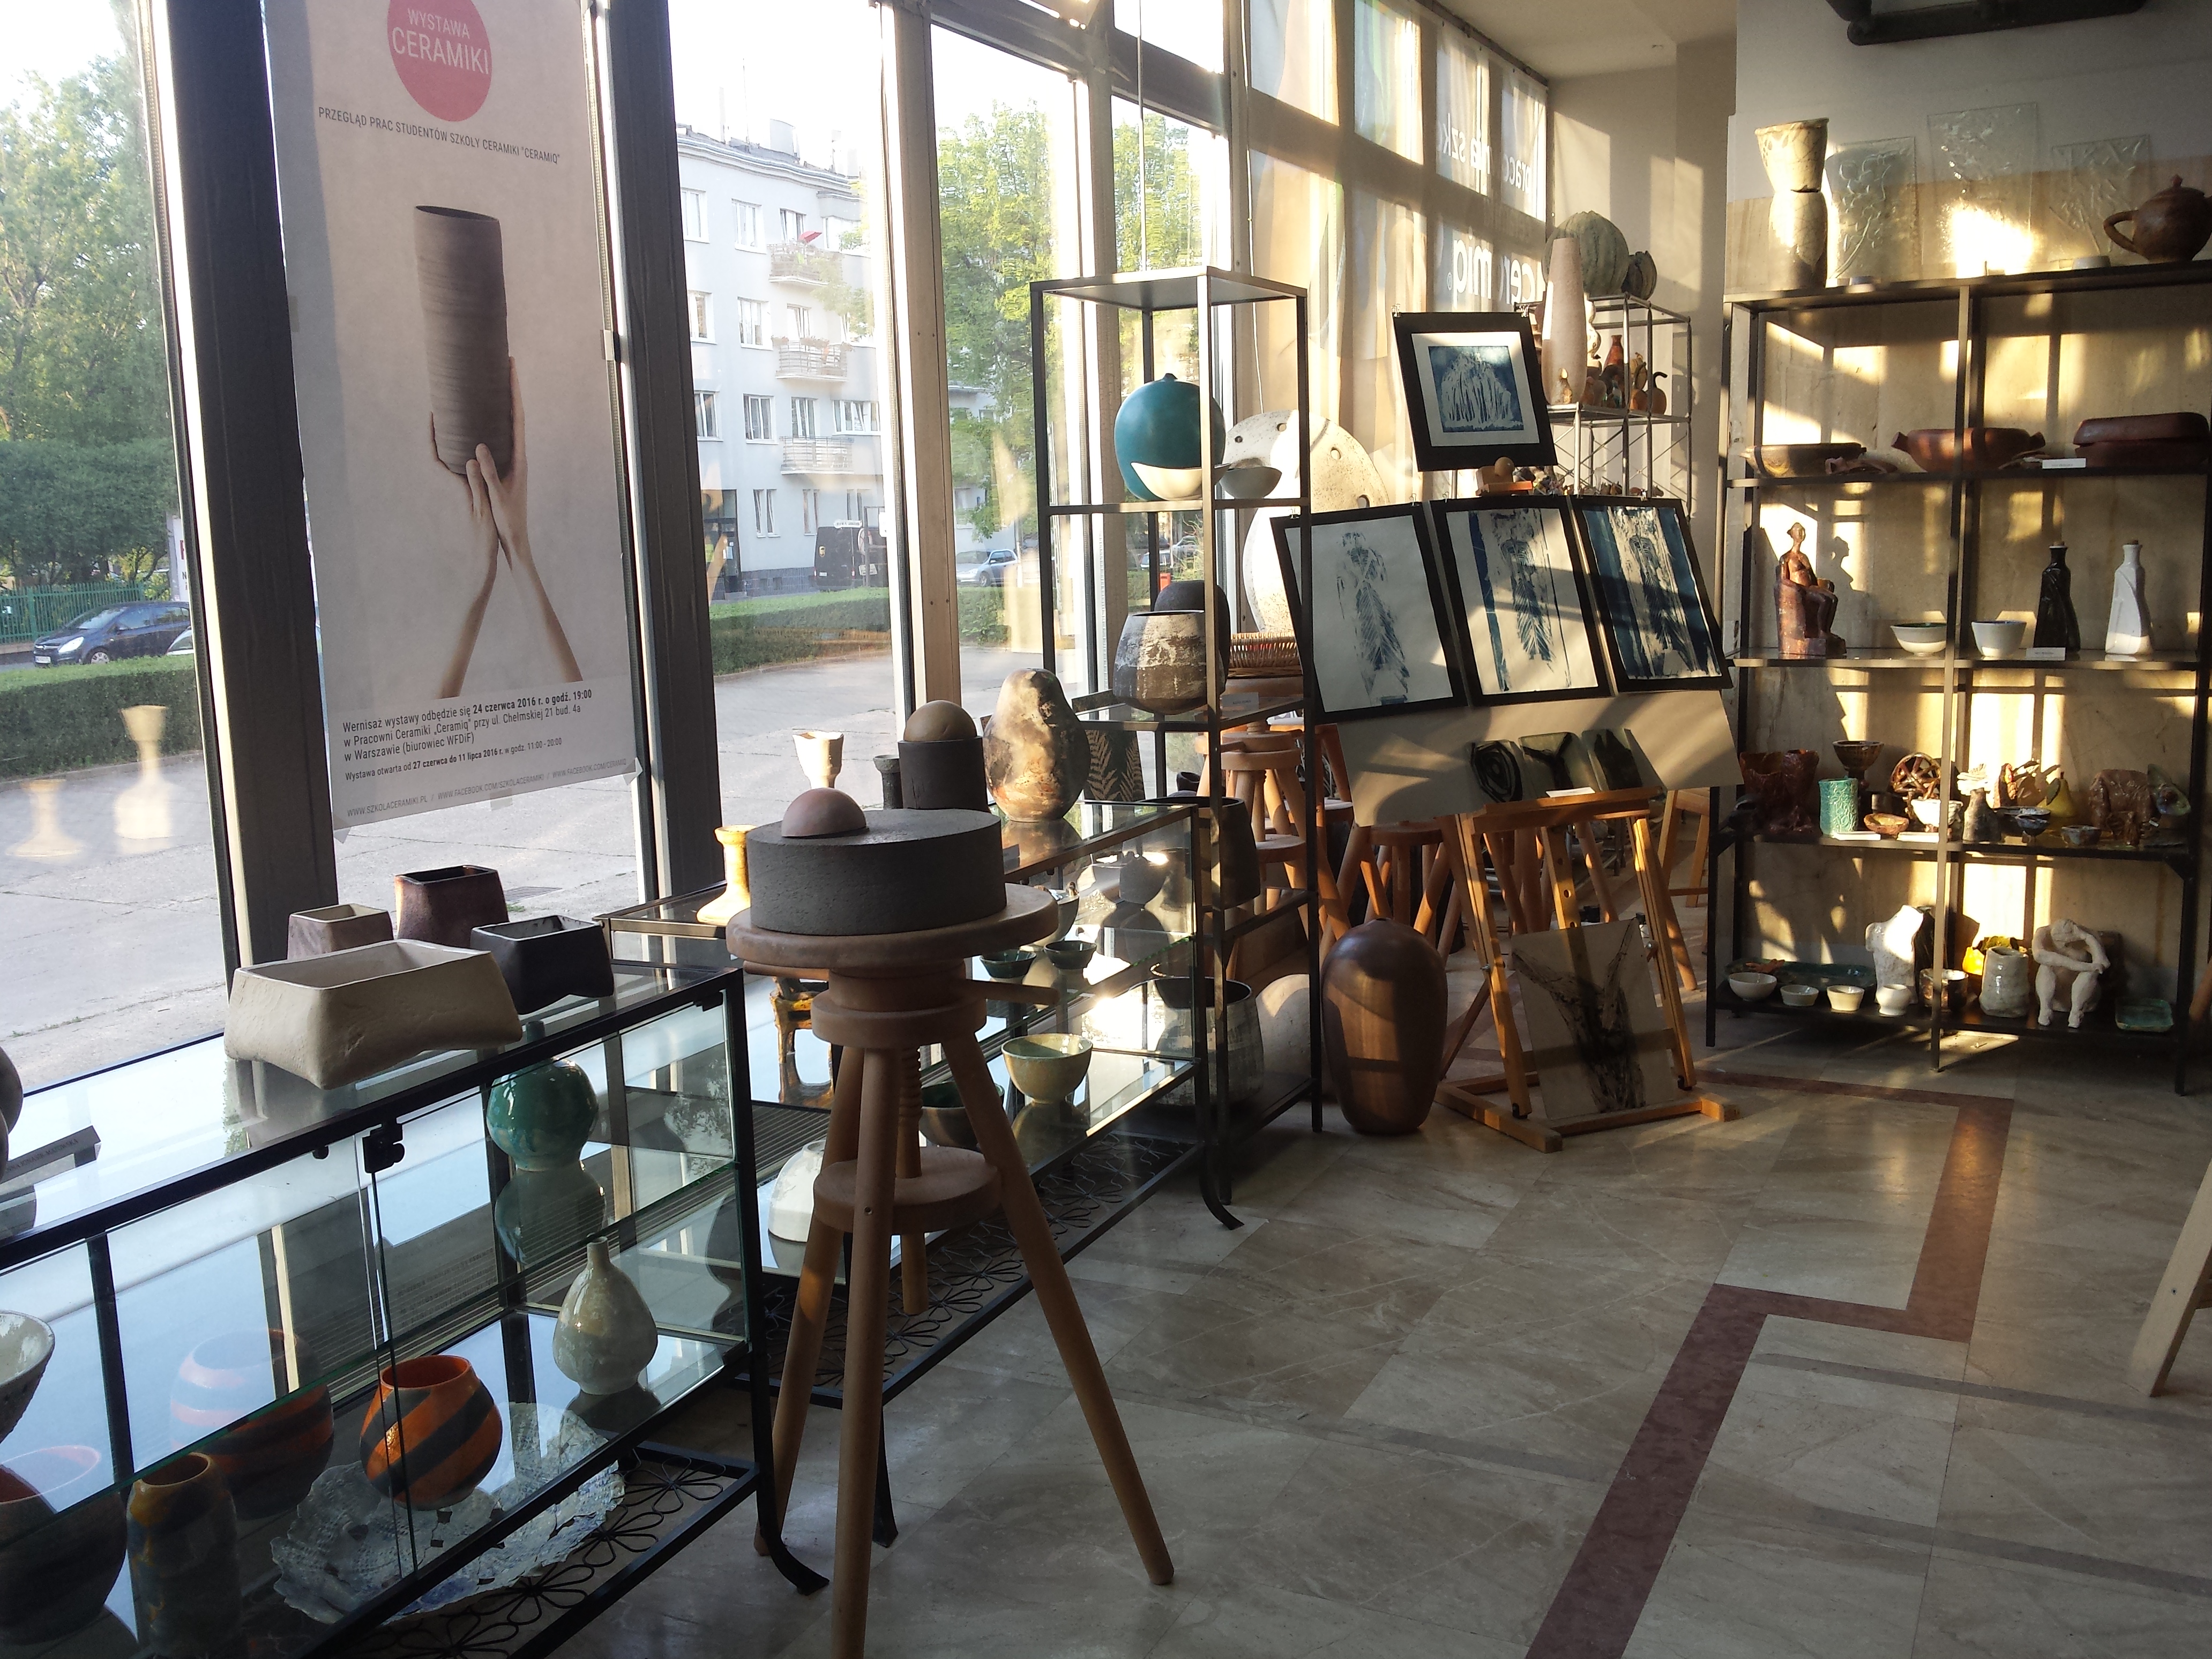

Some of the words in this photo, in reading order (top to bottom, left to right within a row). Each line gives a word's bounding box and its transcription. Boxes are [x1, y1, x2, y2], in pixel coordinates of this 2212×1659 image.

[407, 8, 470, 39] WYSTAWA
[392, 27, 489, 74] CERAMIKI
[318, 107, 367, 128] PRZEGLĄD
[370, 117, 393, 131] PRAC
[396, 122, 447, 141] STUDENTÓW
[483, 139, 520, 156] CERAMIKI
[342, 718, 382, 733] Wernisaż
[385, 714, 420, 729] wystawy
[422, 708, 457, 722] odbędzie
[460, 706, 470, 717] się
[473, 704, 482, 714] 24
[484, 701, 515, 713] czerwca
[517, 697, 536, 708] 2016
[573, 689, 592, 700] 19:00
[343, 739, 351, 748] w
[354, 731, 393, 746] Pracowni
[395, 725, 431, 739] Ceramiki
[474, 719, 490, 730] przy
[545, 707, 553, 718] 21
[555, 705, 571, 715] bud.
[572, 704, 581, 713] 4a
[344, 753, 352, 761] w
[354, 745, 400, 760] Warszawie
[402, 738, 445, 755] (biurowiec
[446, 732, 475, 745] WFDiF)
[345, 769, 376, 782] Wystawa
[377, 764, 402, 775] otwarta
[403, 762, 412, 771] od
[413, 760, 421, 769] 27
[422, 757, 448, 768] czerwca
[449, 754, 457, 763] do
[458, 753, 466, 761] 11
[467, 751, 482, 761] lipca
[483, 748, 498, 758] 2016
[527, 741, 542, 750] 11:00
[547, 737, 562, 747] 20:00
